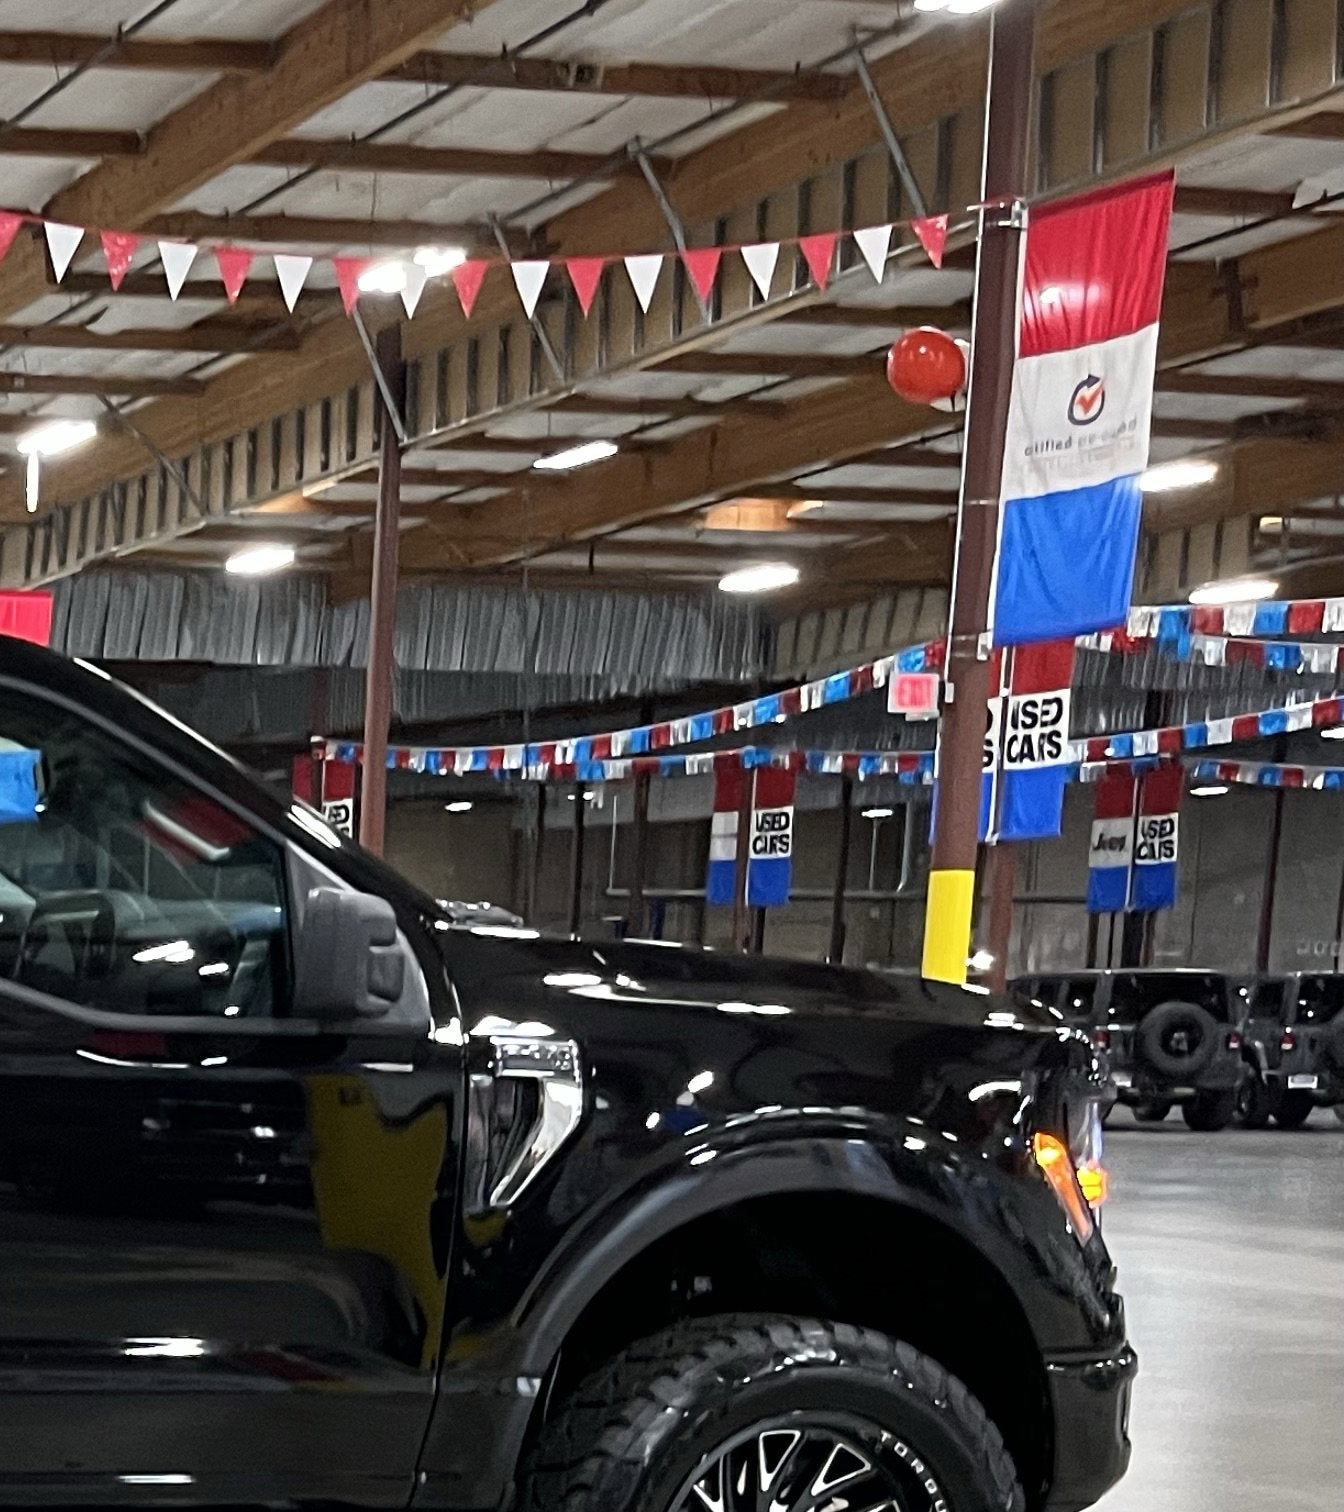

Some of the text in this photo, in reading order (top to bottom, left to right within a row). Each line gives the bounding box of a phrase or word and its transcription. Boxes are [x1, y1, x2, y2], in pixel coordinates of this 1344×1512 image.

[1007, 730, 1062, 764] CARS
[756, 812, 790, 832] USED
[1141, 818, 1175, 840] USED
[753, 834, 790, 854] CARS
